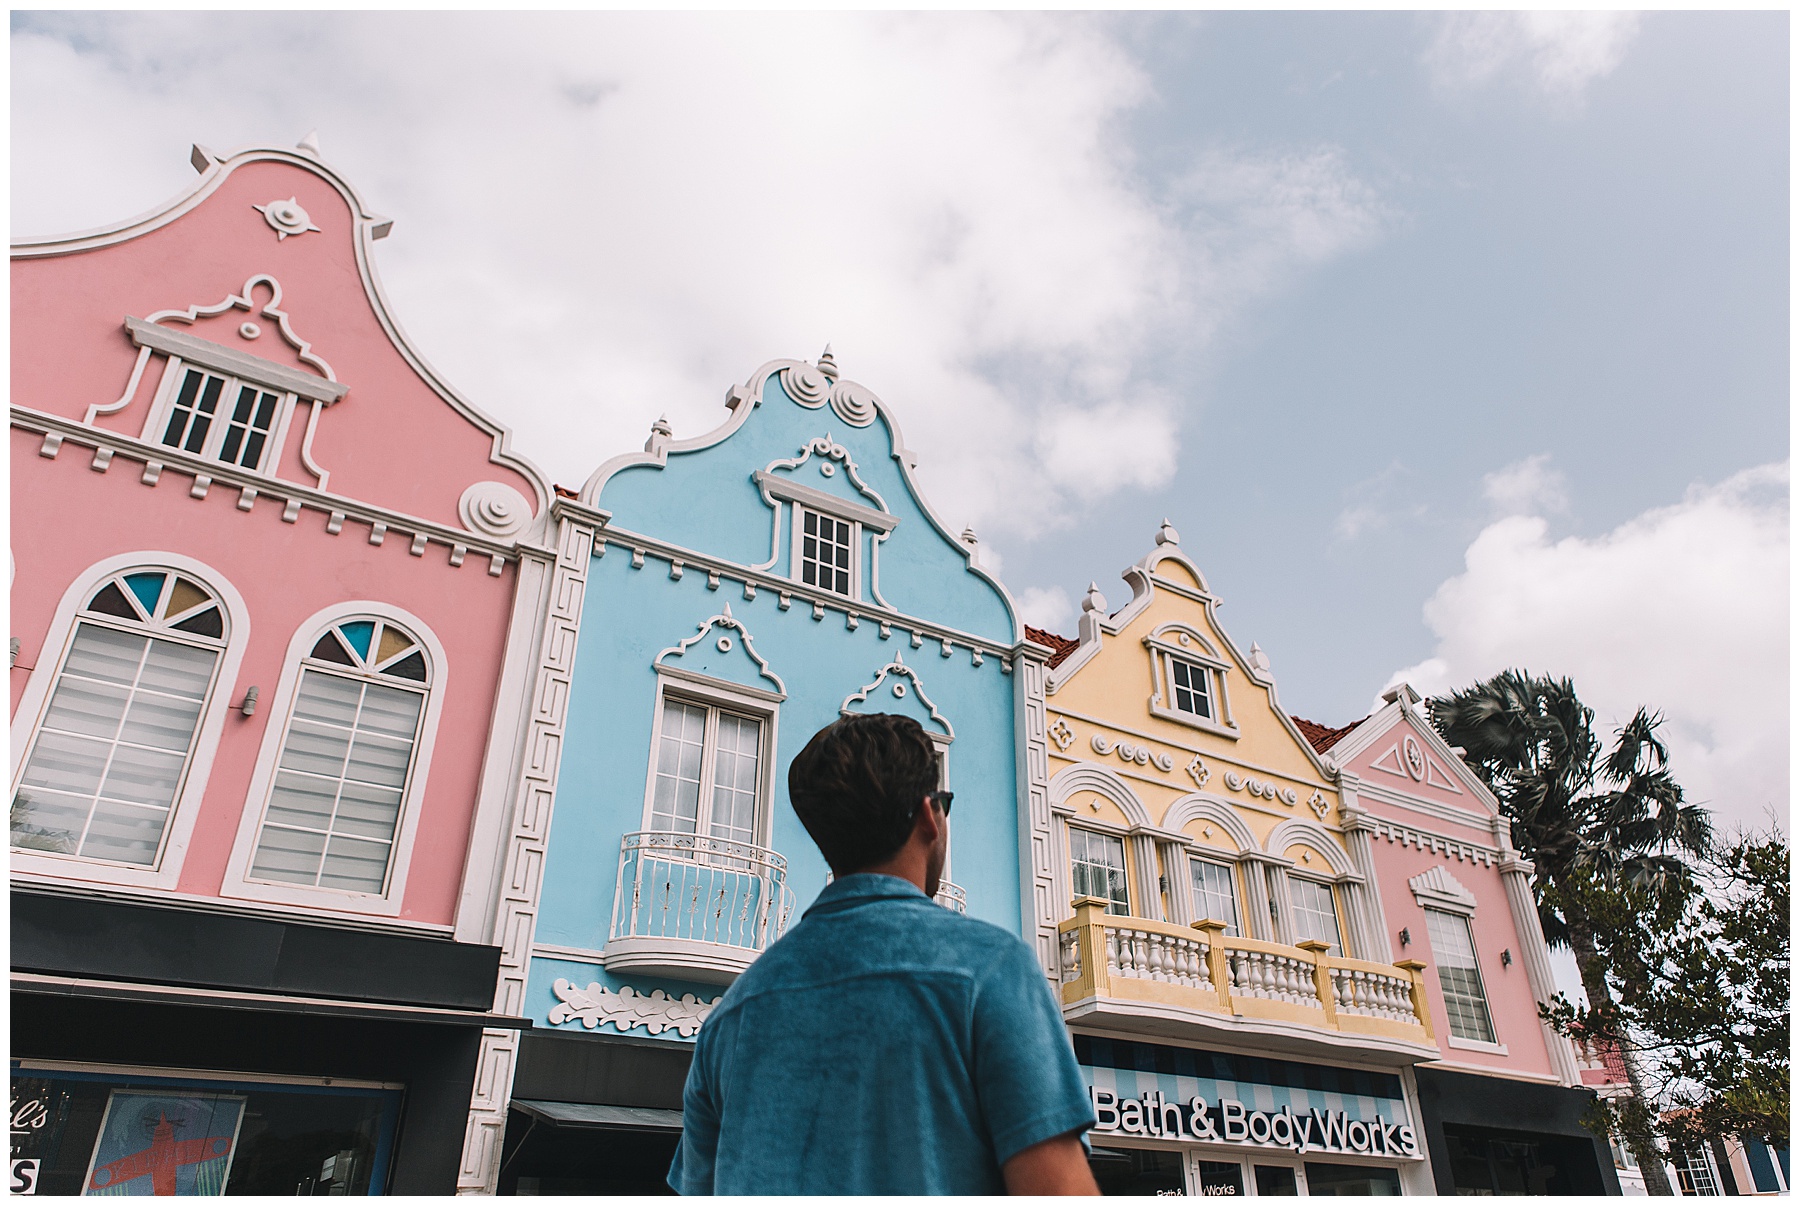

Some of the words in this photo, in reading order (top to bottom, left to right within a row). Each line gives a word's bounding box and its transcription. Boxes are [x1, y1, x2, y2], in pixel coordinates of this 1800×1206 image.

[10, 1099, 49, 1128] l's
[1090, 1086, 1183, 1137] Bath
[1189, 1096, 1218, 1141] &
[1219, 1098, 1313, 1154] Body
[1310, 1107, 1417, 1156] Works
[1205, 1183, 1236, 1196] Works
